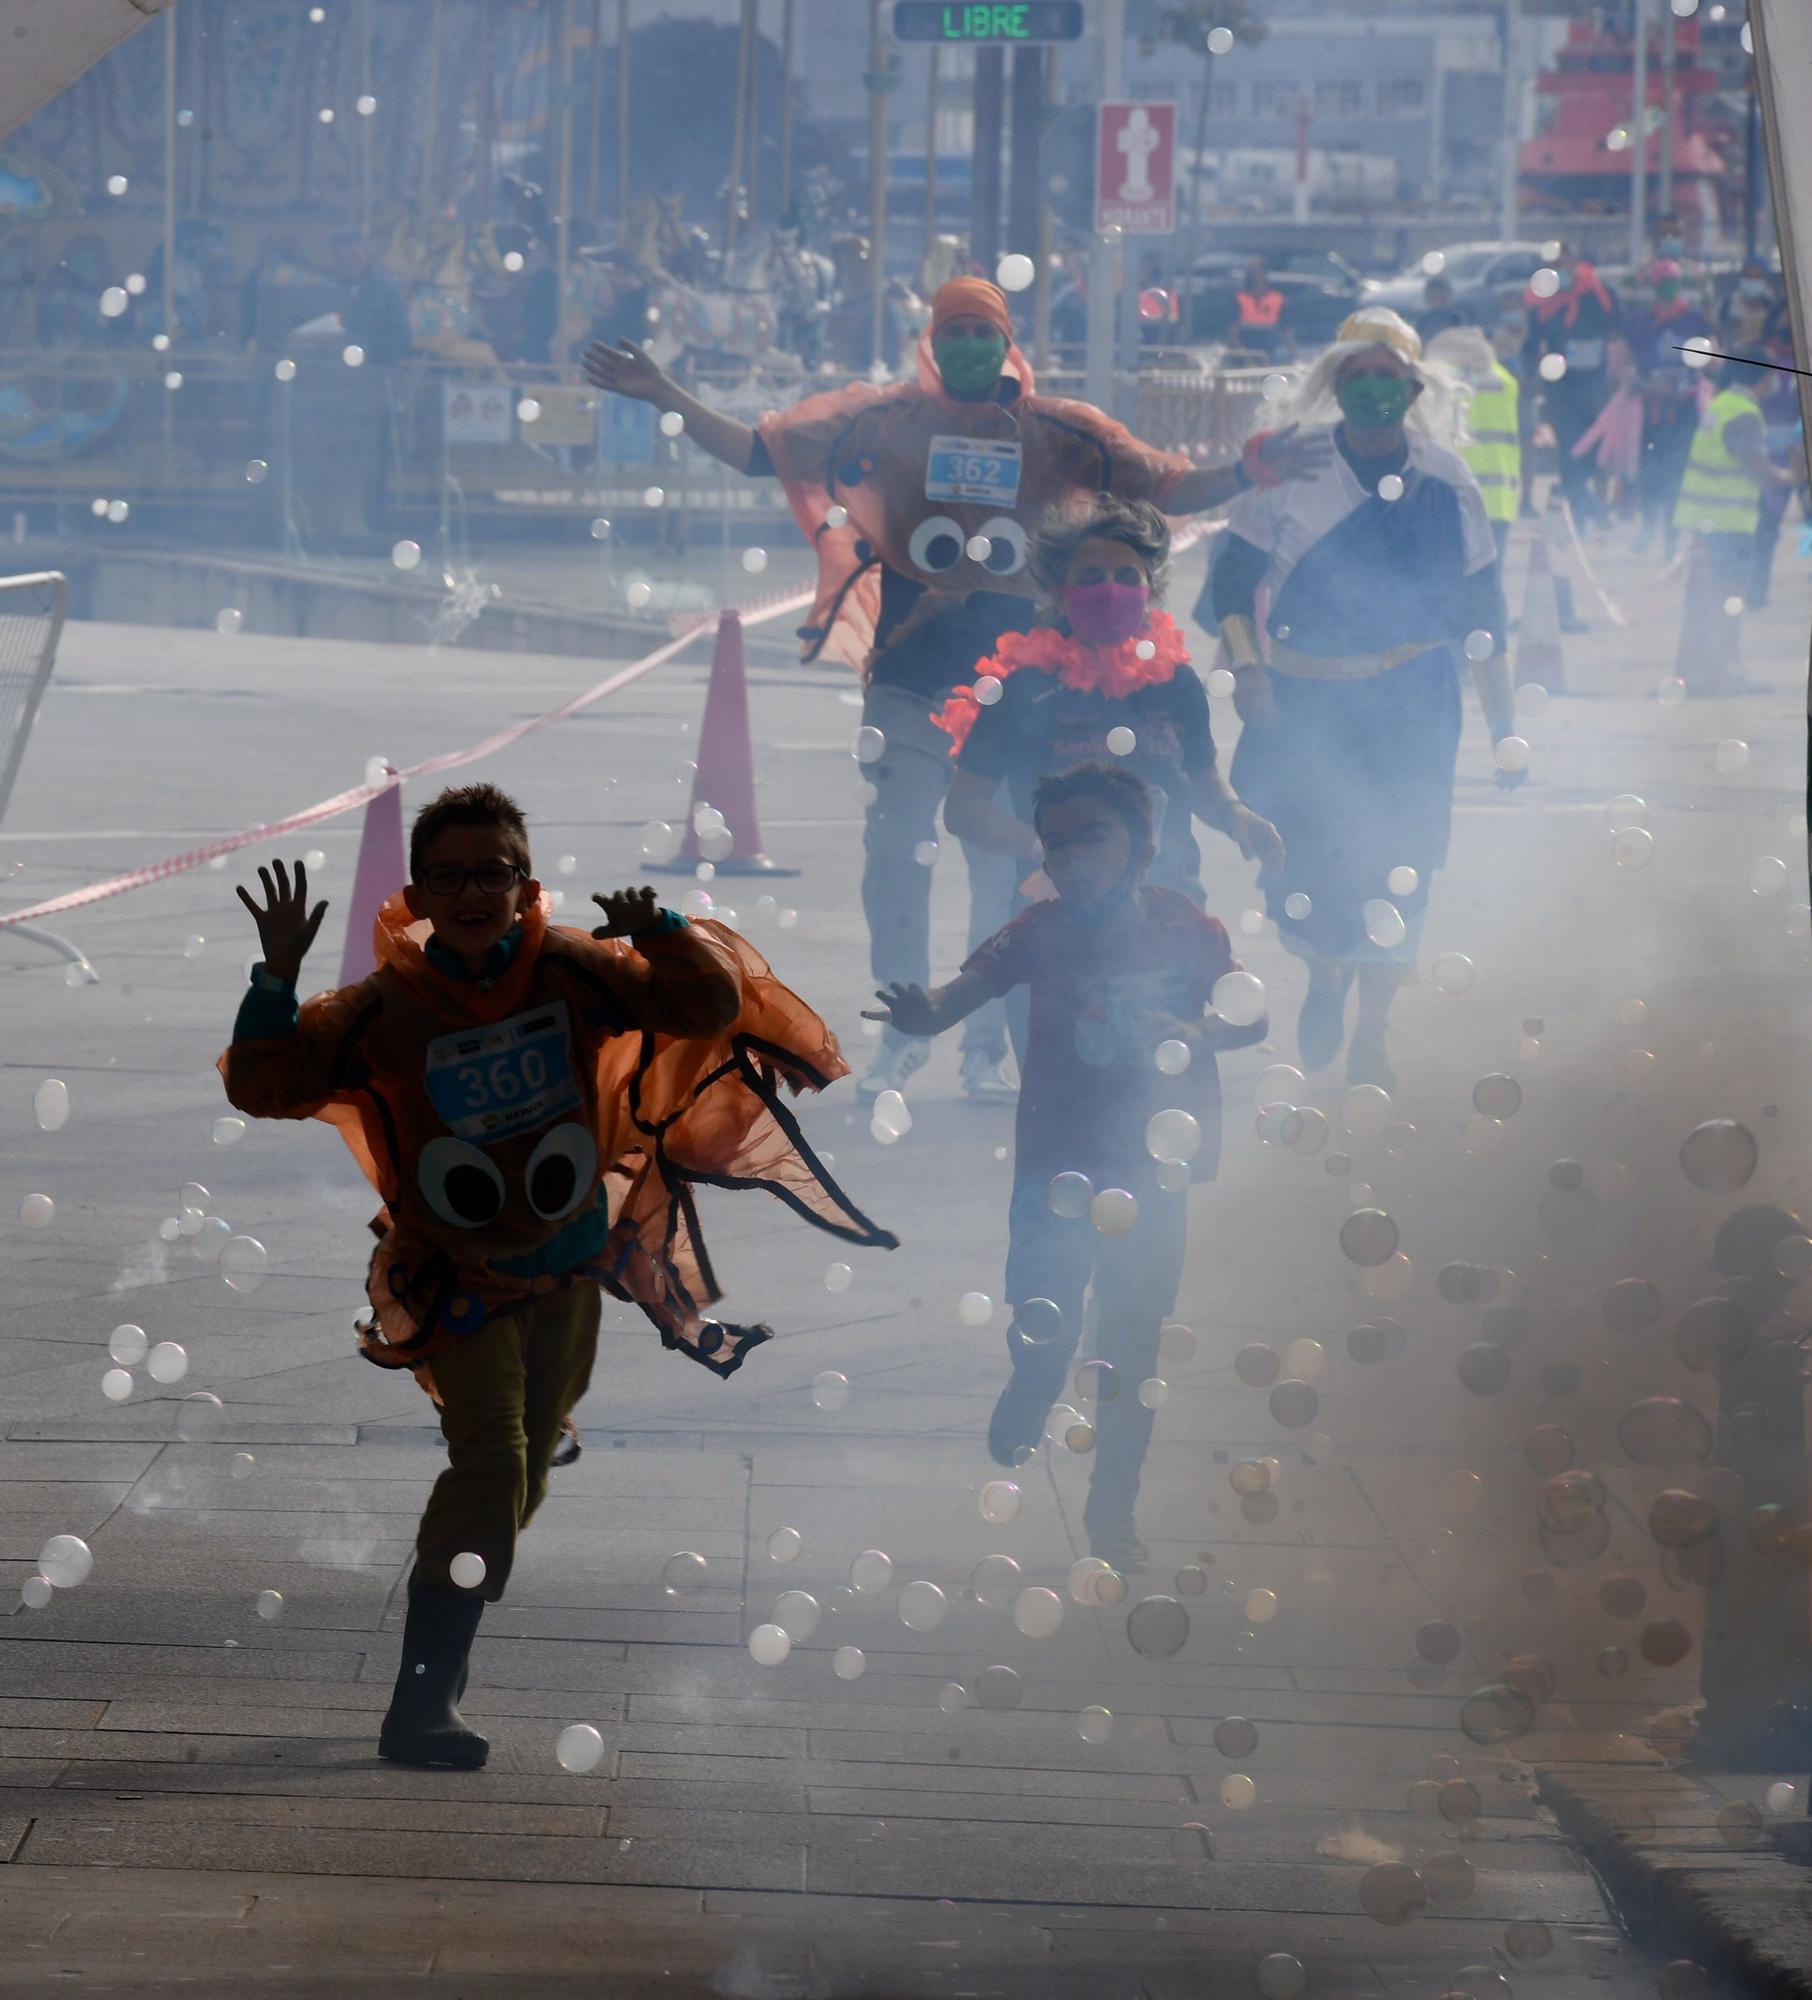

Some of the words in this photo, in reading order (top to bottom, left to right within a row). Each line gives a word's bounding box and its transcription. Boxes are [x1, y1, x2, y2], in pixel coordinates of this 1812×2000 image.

[943, 4, 1030, 39] LIBRE
[947, 455, 1001, 483] 362
[458, 1049, 546, 1107] 360
